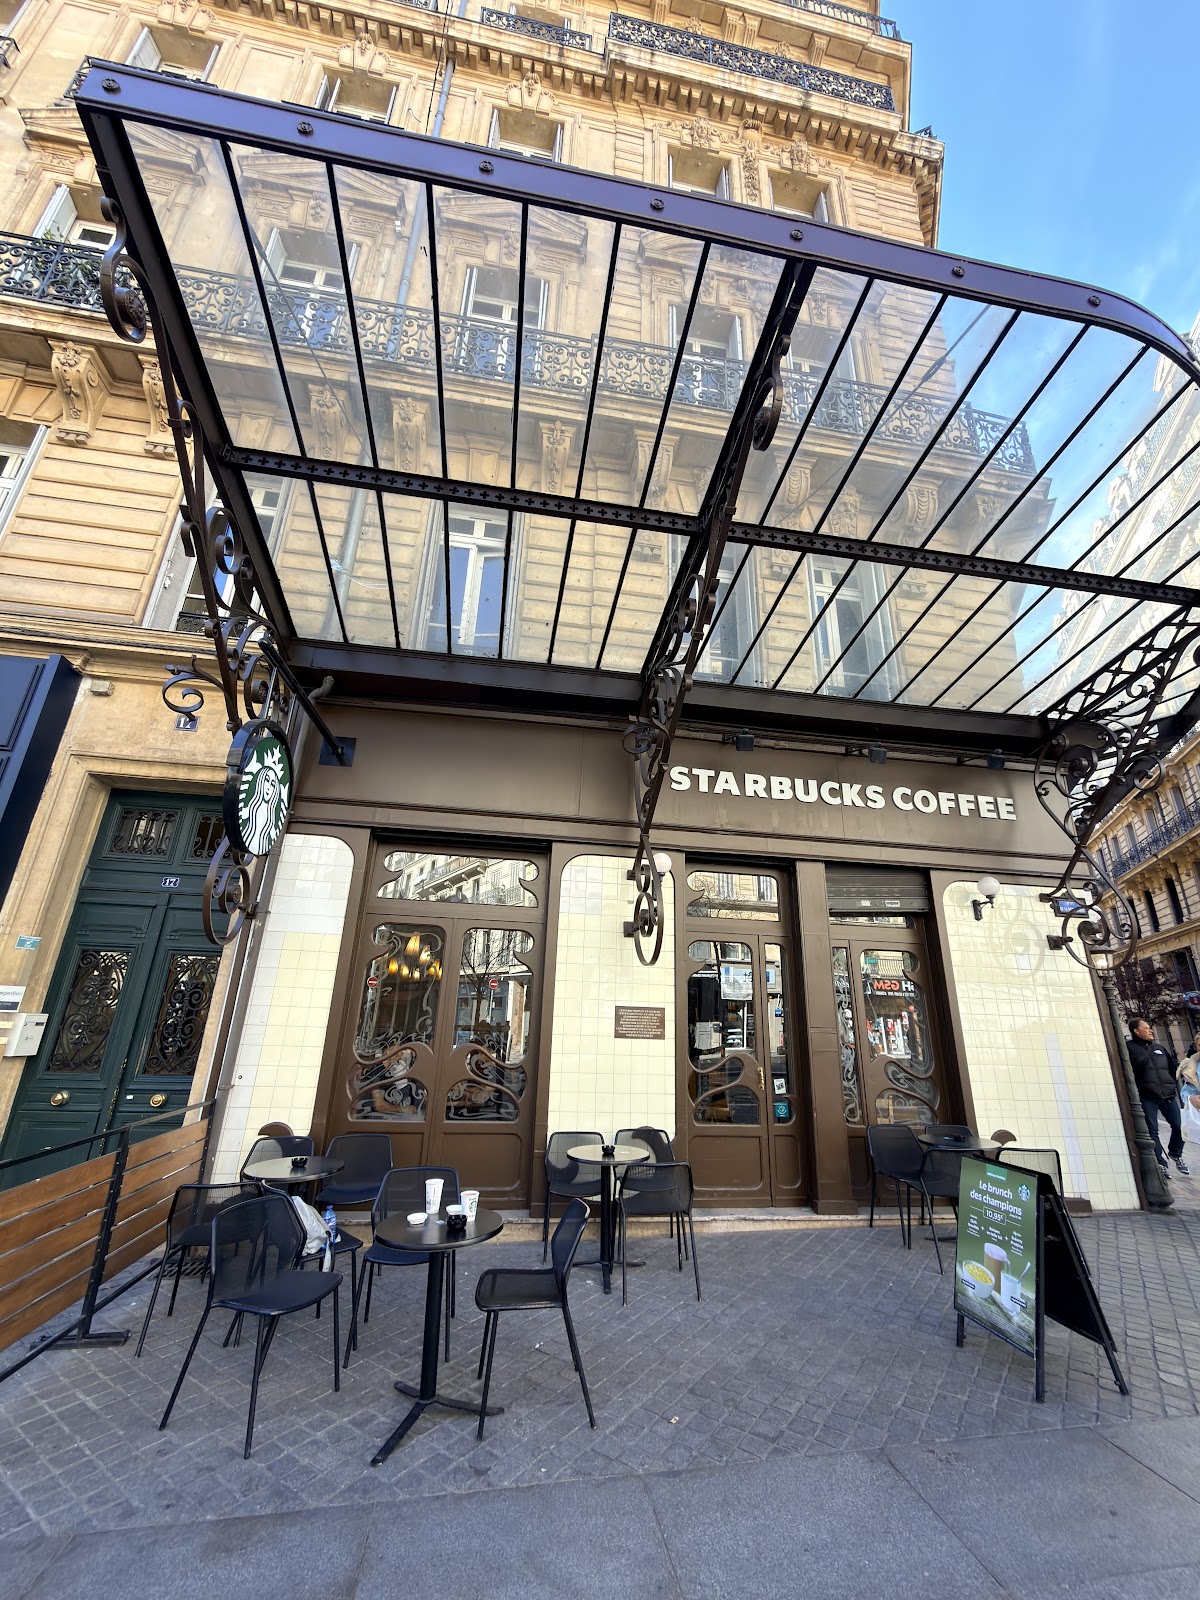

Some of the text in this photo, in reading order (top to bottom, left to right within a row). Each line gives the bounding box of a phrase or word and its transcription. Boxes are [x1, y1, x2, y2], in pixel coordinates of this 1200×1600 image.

[669, 766, 1017, 821] STARBUCKS COFFEE
[164, 878, 177, 886] 17
[979, 1180, 1013, 1200] Le brunch
[970, 1189, 1022, 1216] des champions
